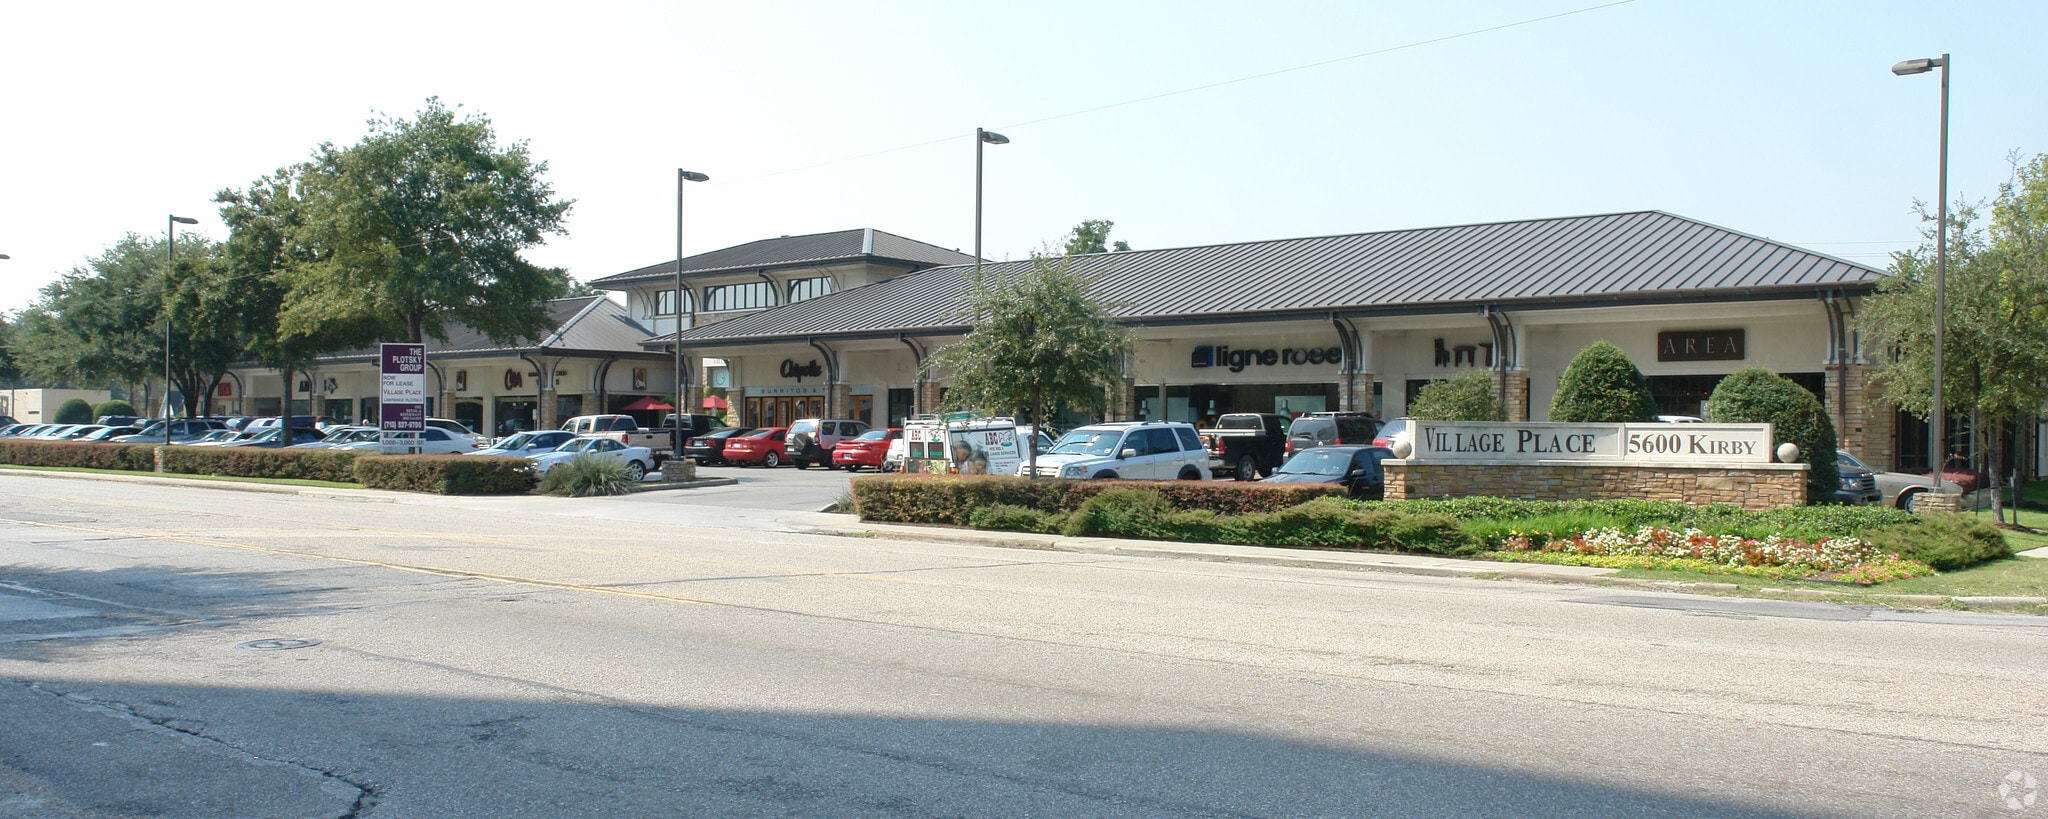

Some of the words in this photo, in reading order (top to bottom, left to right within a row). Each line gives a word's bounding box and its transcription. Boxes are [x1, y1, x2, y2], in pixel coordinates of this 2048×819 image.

[409, 348, 422, 356] THE
[1663, 336, 1737, 354] AREA
[392, 355, 422, 364] PLOTSKY
[400, 364, 422, 372] GROUP
[1216, 346, 1279, 373] ligne
[780, 359, 822, 383] Chipotle
[985, 432, 998, 446] ABC
[1424, 428, 1505, 453] VILLAGE
[1516, 430, 1597, 453] PLACE
[1629, 434, 1682, 454] 5600
[1688, 434, 1757, 455] KIRBY
